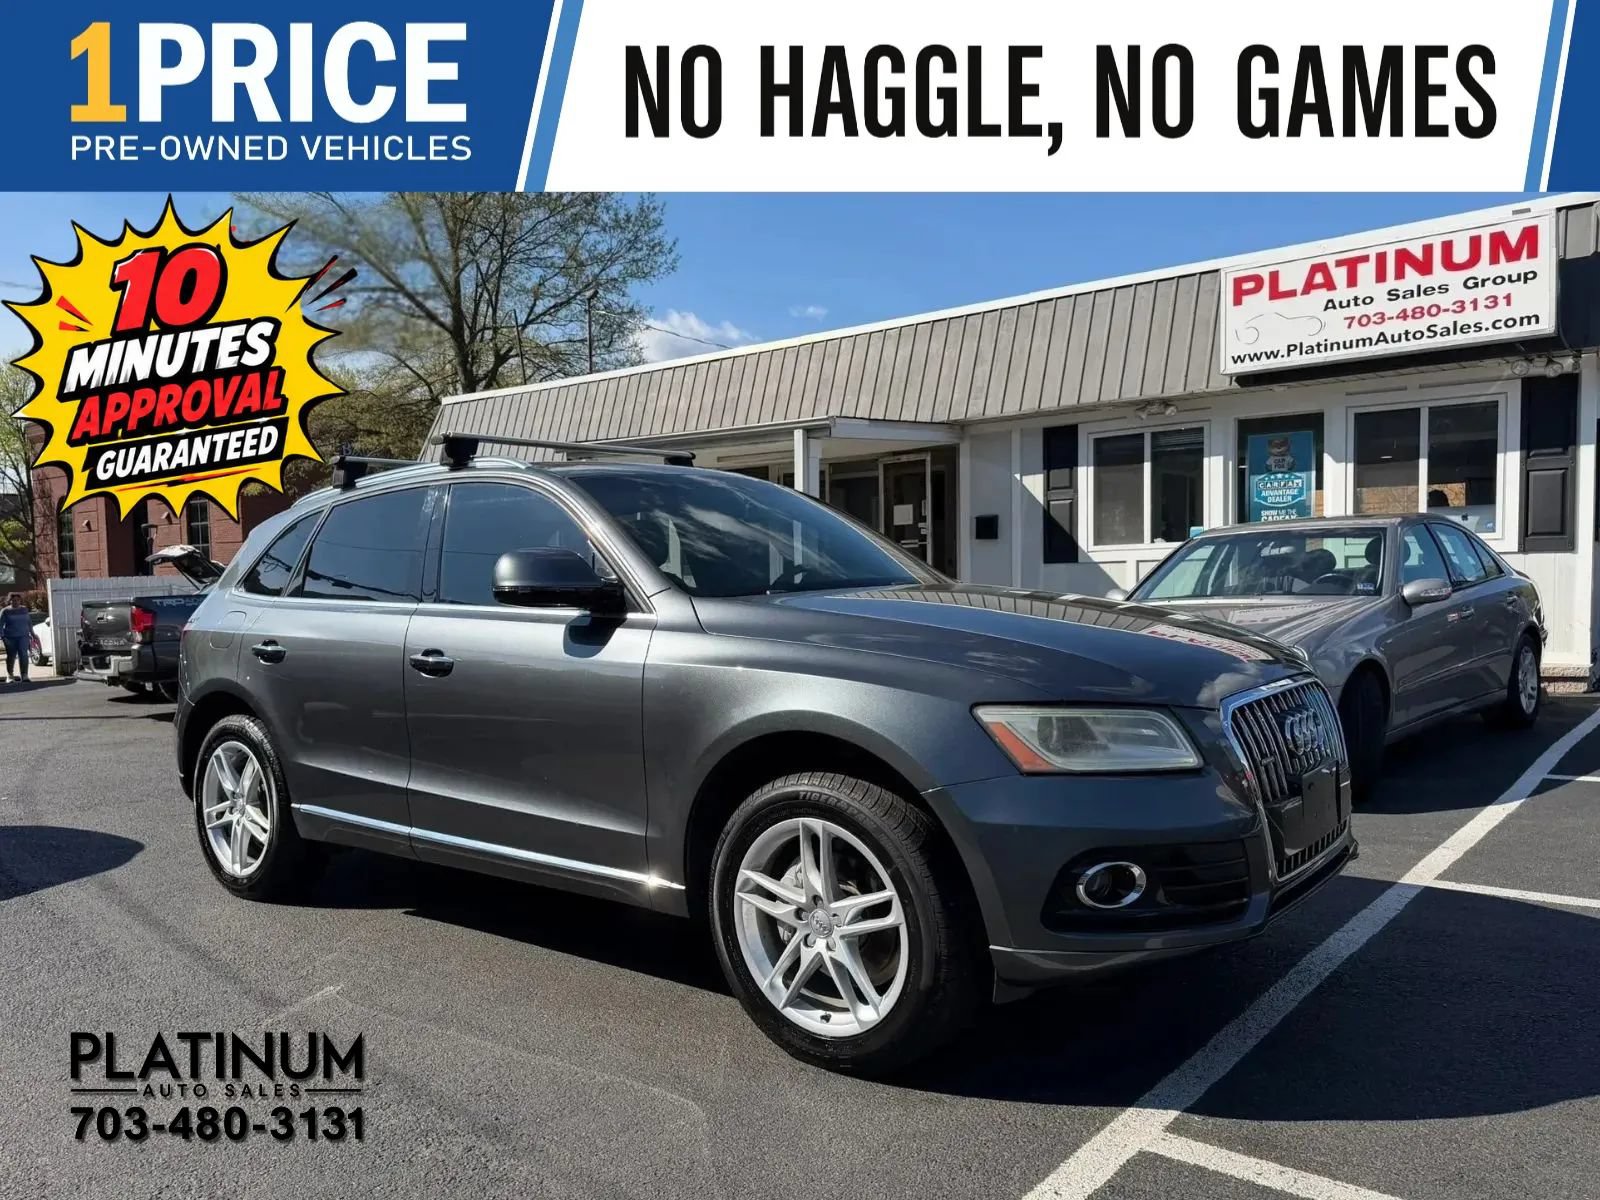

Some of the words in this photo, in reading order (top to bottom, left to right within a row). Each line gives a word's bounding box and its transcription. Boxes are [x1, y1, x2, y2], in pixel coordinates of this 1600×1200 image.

[1232, 224, 1539, 307] PLATINUM
[1323, 295, 1375, 312] Auto
[1386, 283, 1450, 302] Sales
[1462, 269, 1538, 290] Group
[1343, 292, 1513, 330] 703-480-3131
[1231, 313, 1540, 364] www.PlatinumAutoSales.com
[1258, 479, 1302, 489] CARFAX
[1260, 489, 1299, 497] ADVANTAGE
[799, 791, 837, 807] TIGER
